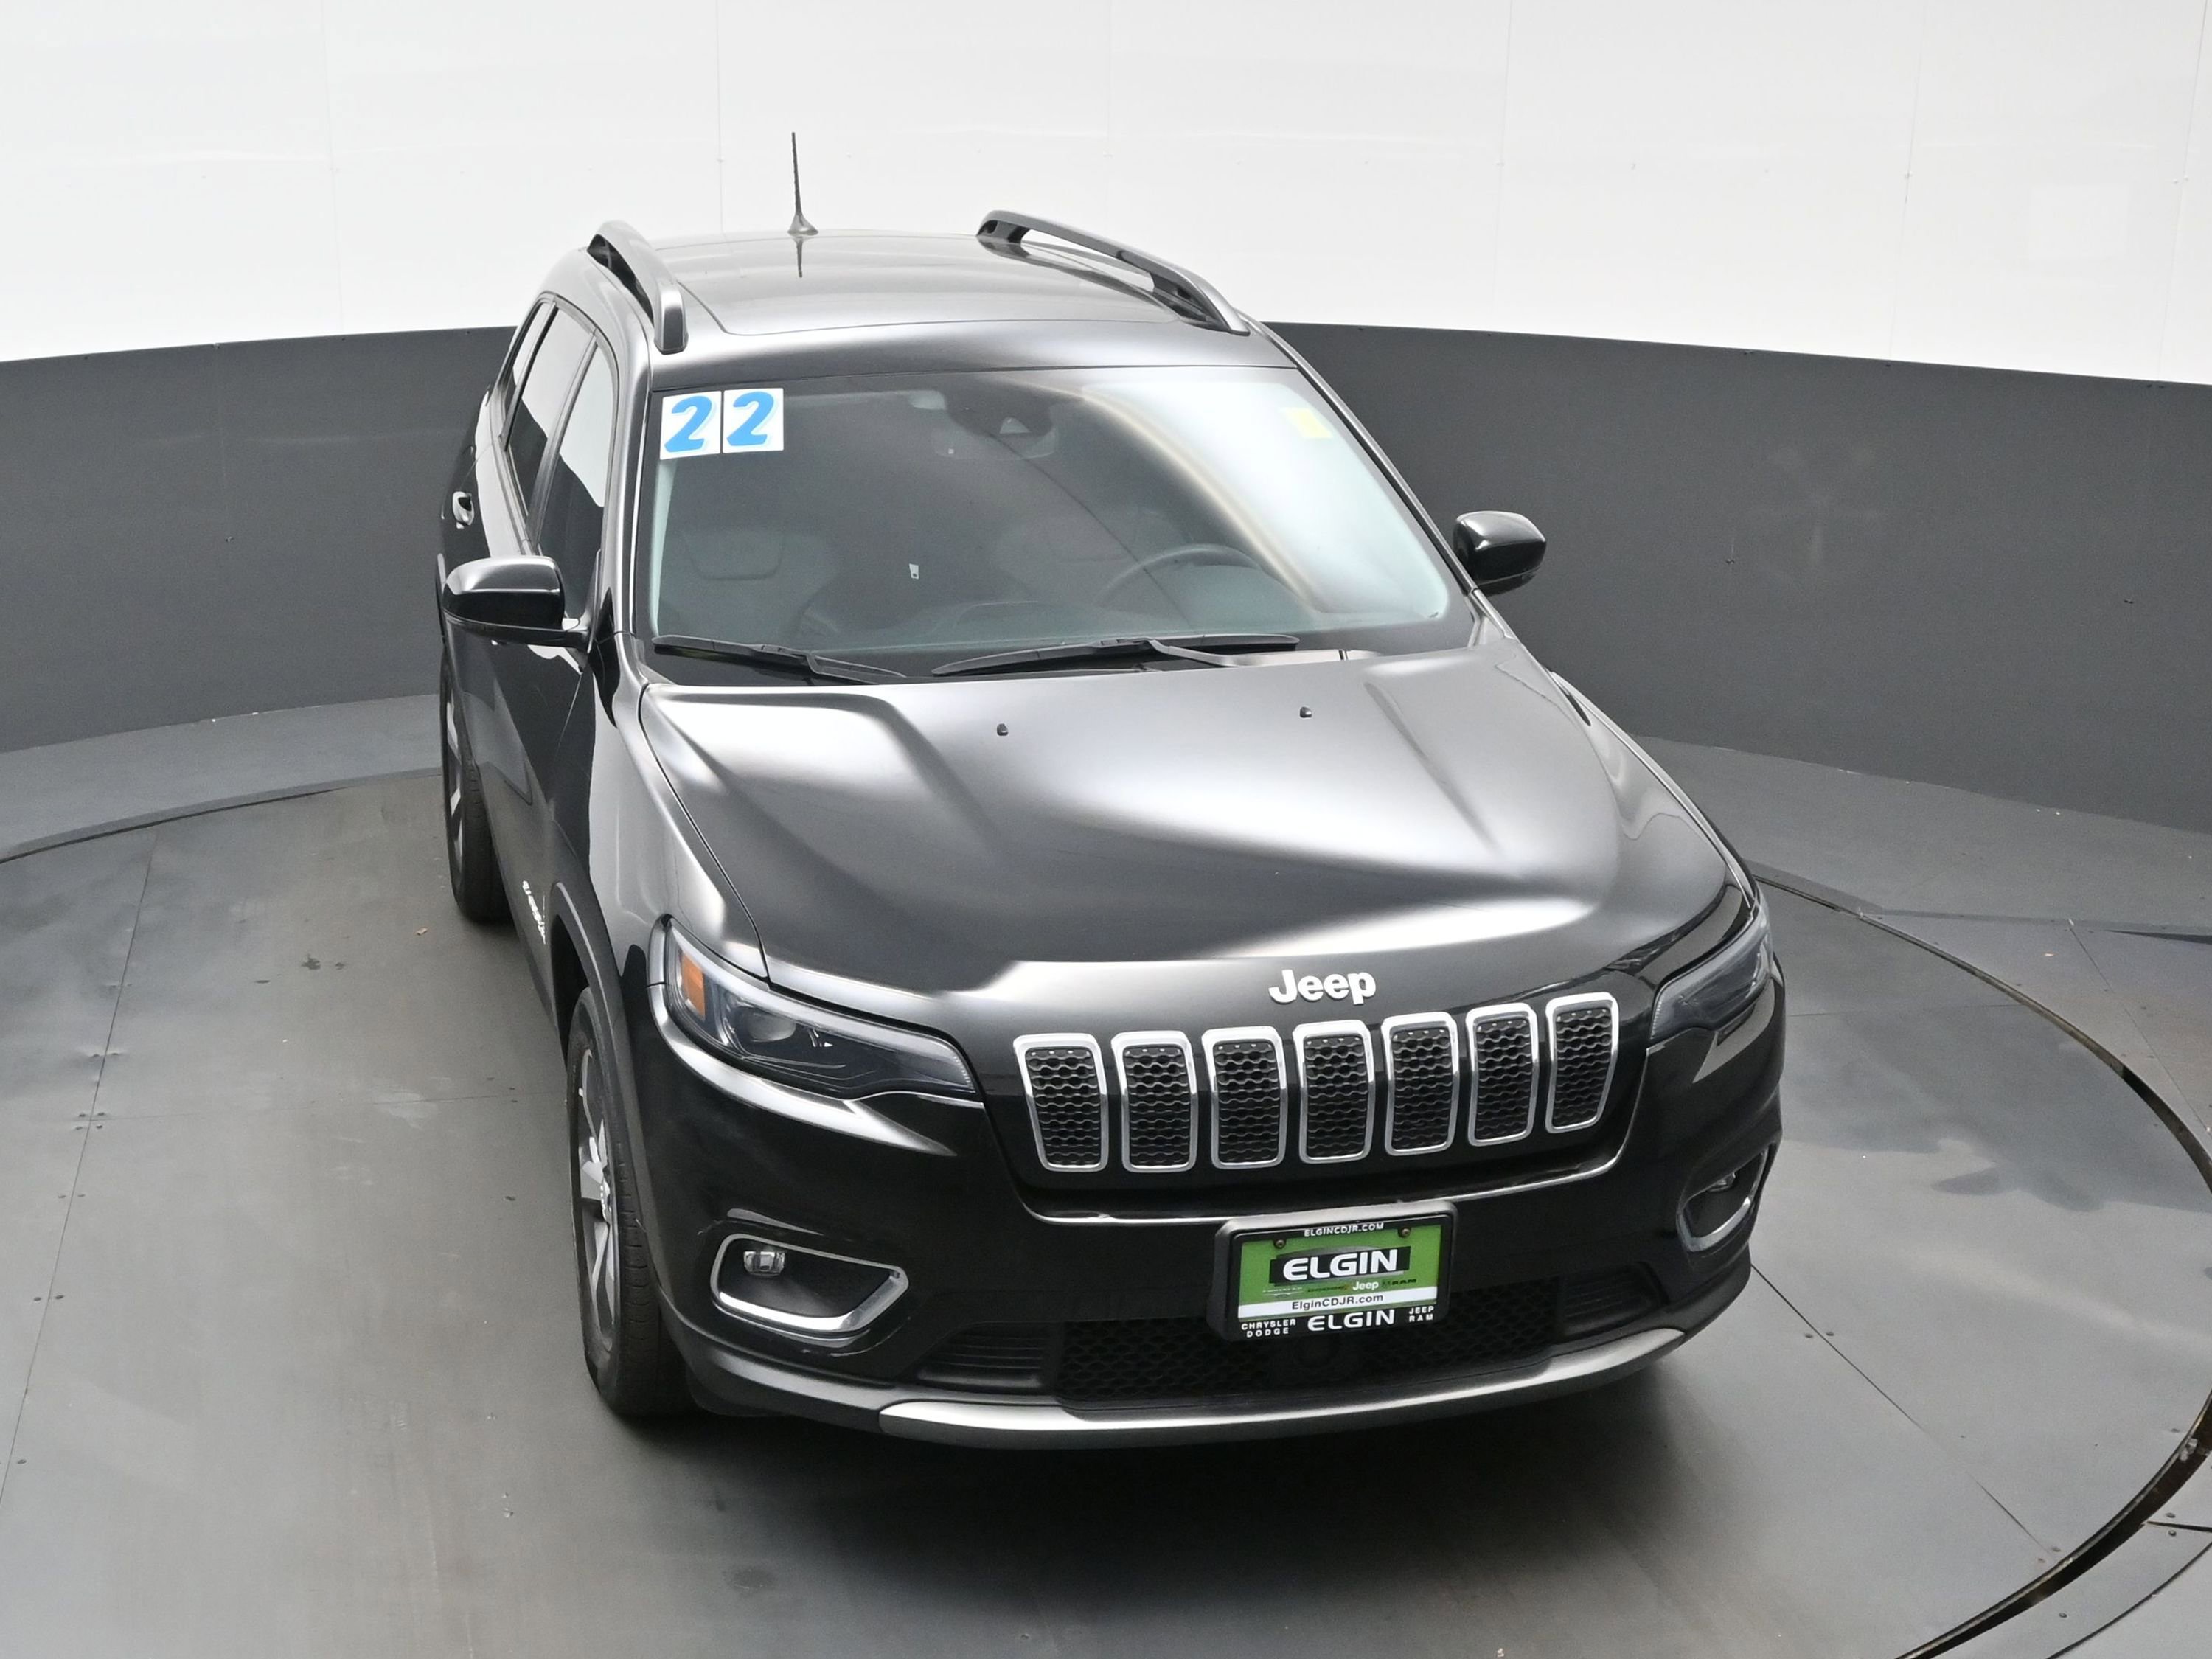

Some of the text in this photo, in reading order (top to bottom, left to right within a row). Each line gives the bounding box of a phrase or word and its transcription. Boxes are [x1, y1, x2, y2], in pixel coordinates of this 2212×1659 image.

[664, 391, 774, 452] 22
[1268, 970, 1376, 1005] Jeep
[1304, 1222, 1384, 1237] ELGINCDJR.COM
[1283, 1248, 1398, 1281] ELGIN
[1352, 1281, 1379, 1290] Jeep
[1292, 1294, 1384, 1311] ElginCDJR.com
[1409, 1305, 1435, 1315] JEEP
[1241, 1318, 1296, 1331] CHRYSLER
[1307, 1309, 1395, 1332] ELGIN
[1409, 1313, 1433, 1322] RAM
[1246, 1328, 1290, 1338] DODGE
